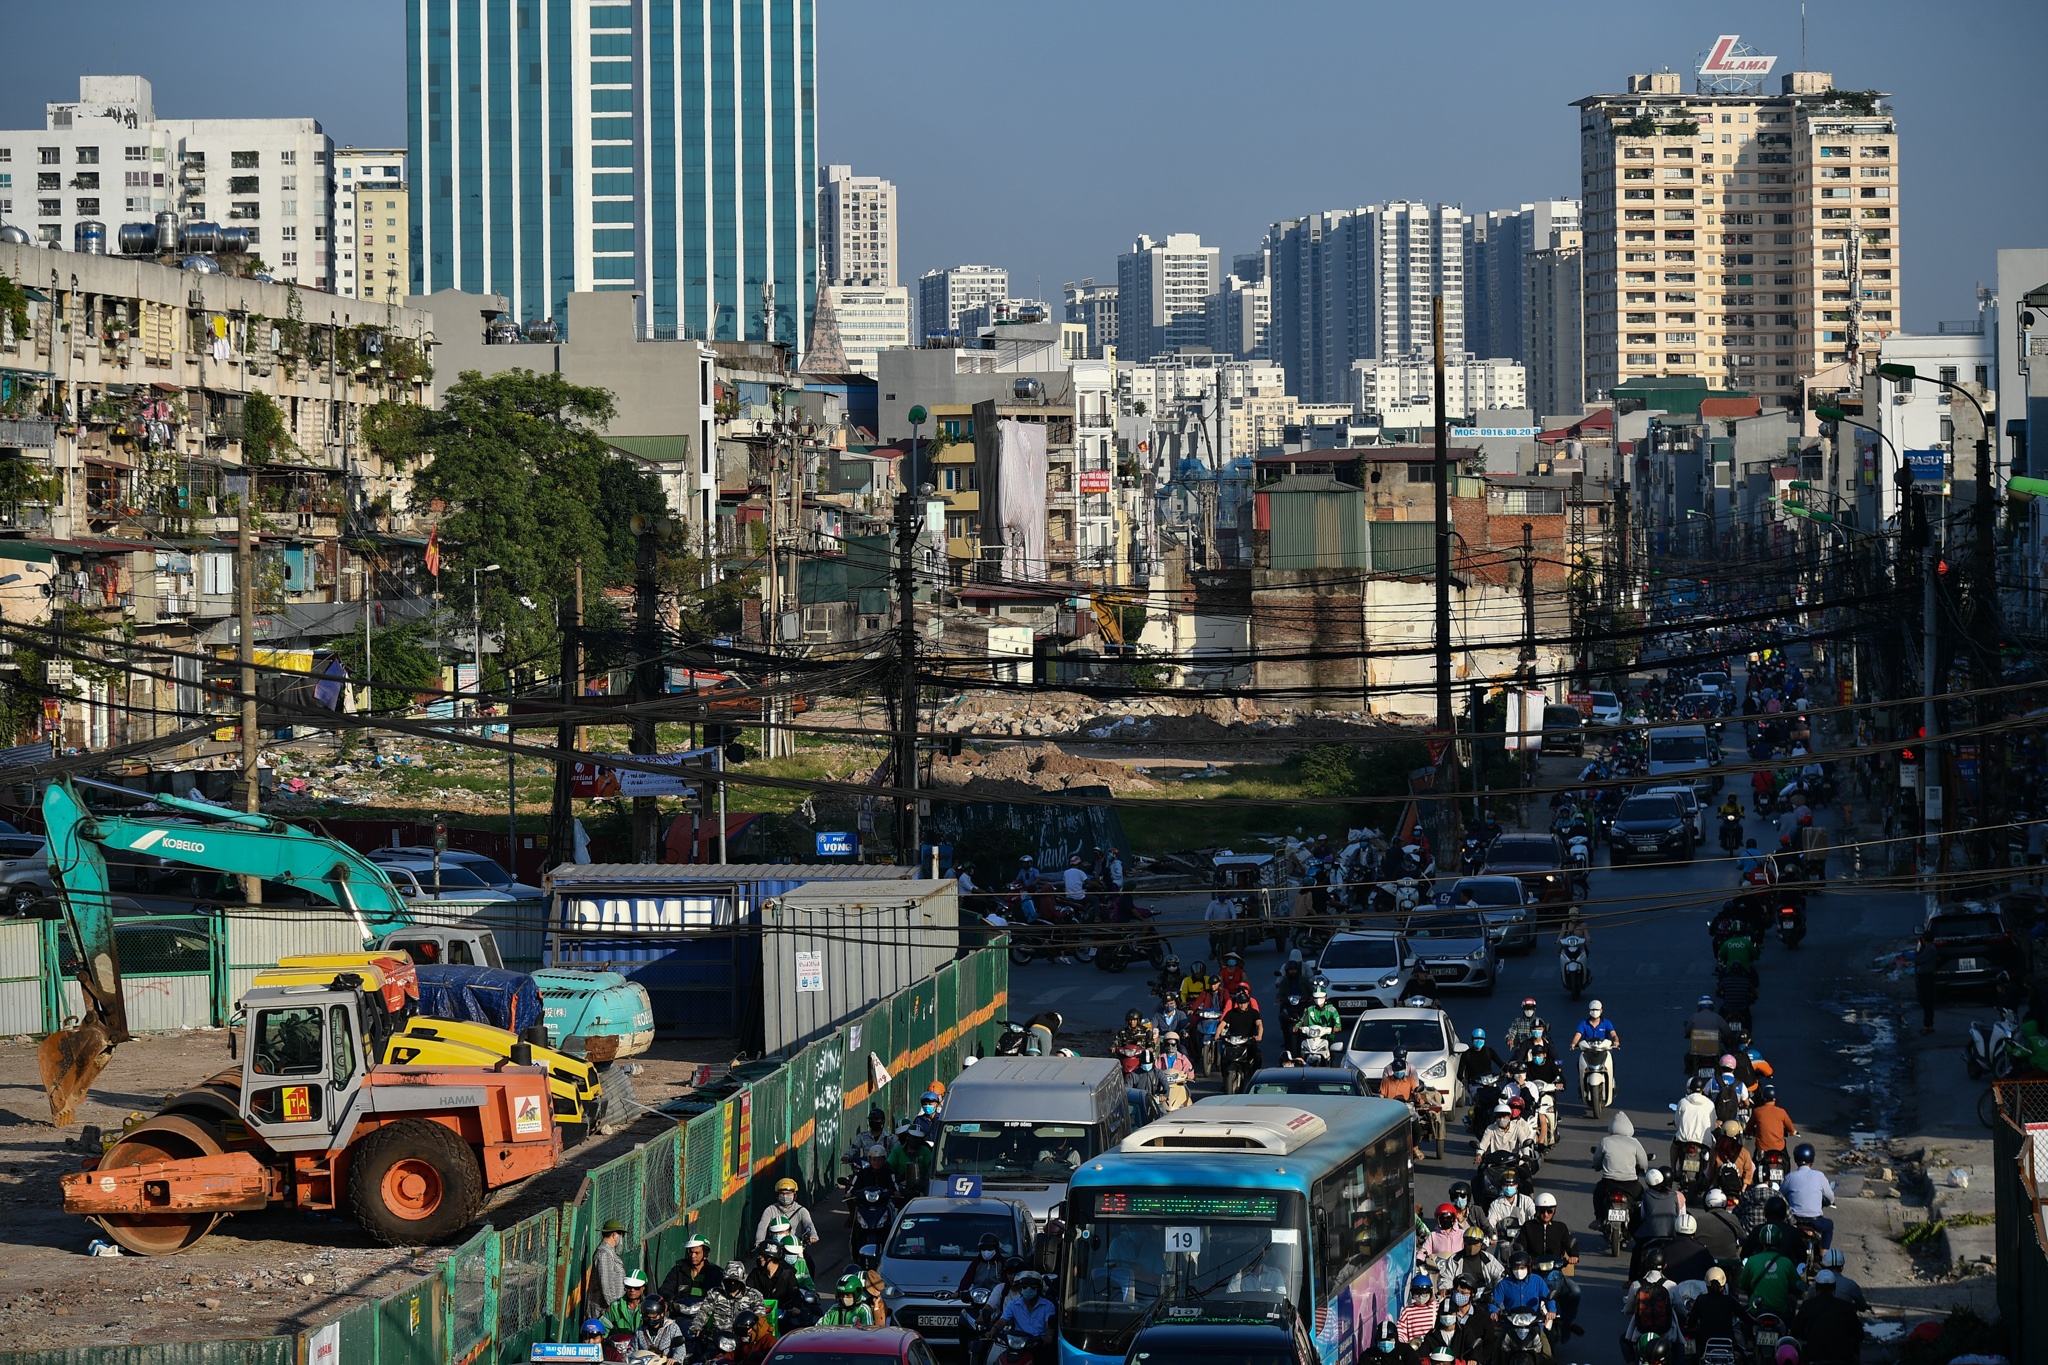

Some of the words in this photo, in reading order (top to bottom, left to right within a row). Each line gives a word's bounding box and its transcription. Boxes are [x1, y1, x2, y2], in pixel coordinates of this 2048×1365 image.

[1706, 38, 1768, 70] LILAMA
[162, 838, 205, 853] KOBELCO
[823, 842, 852, 853] VỌNG
[1727, 941, 1746, 949] Grab
[439, 1095, 475, 1106] HAMM
[955, 1177, 974, 1196] G7
[1172, 1232, 1193, 1248] 19
[556, 1344, 577, 1356] SÔNG
[578, 1344, 598, 1358] NHUỆ
